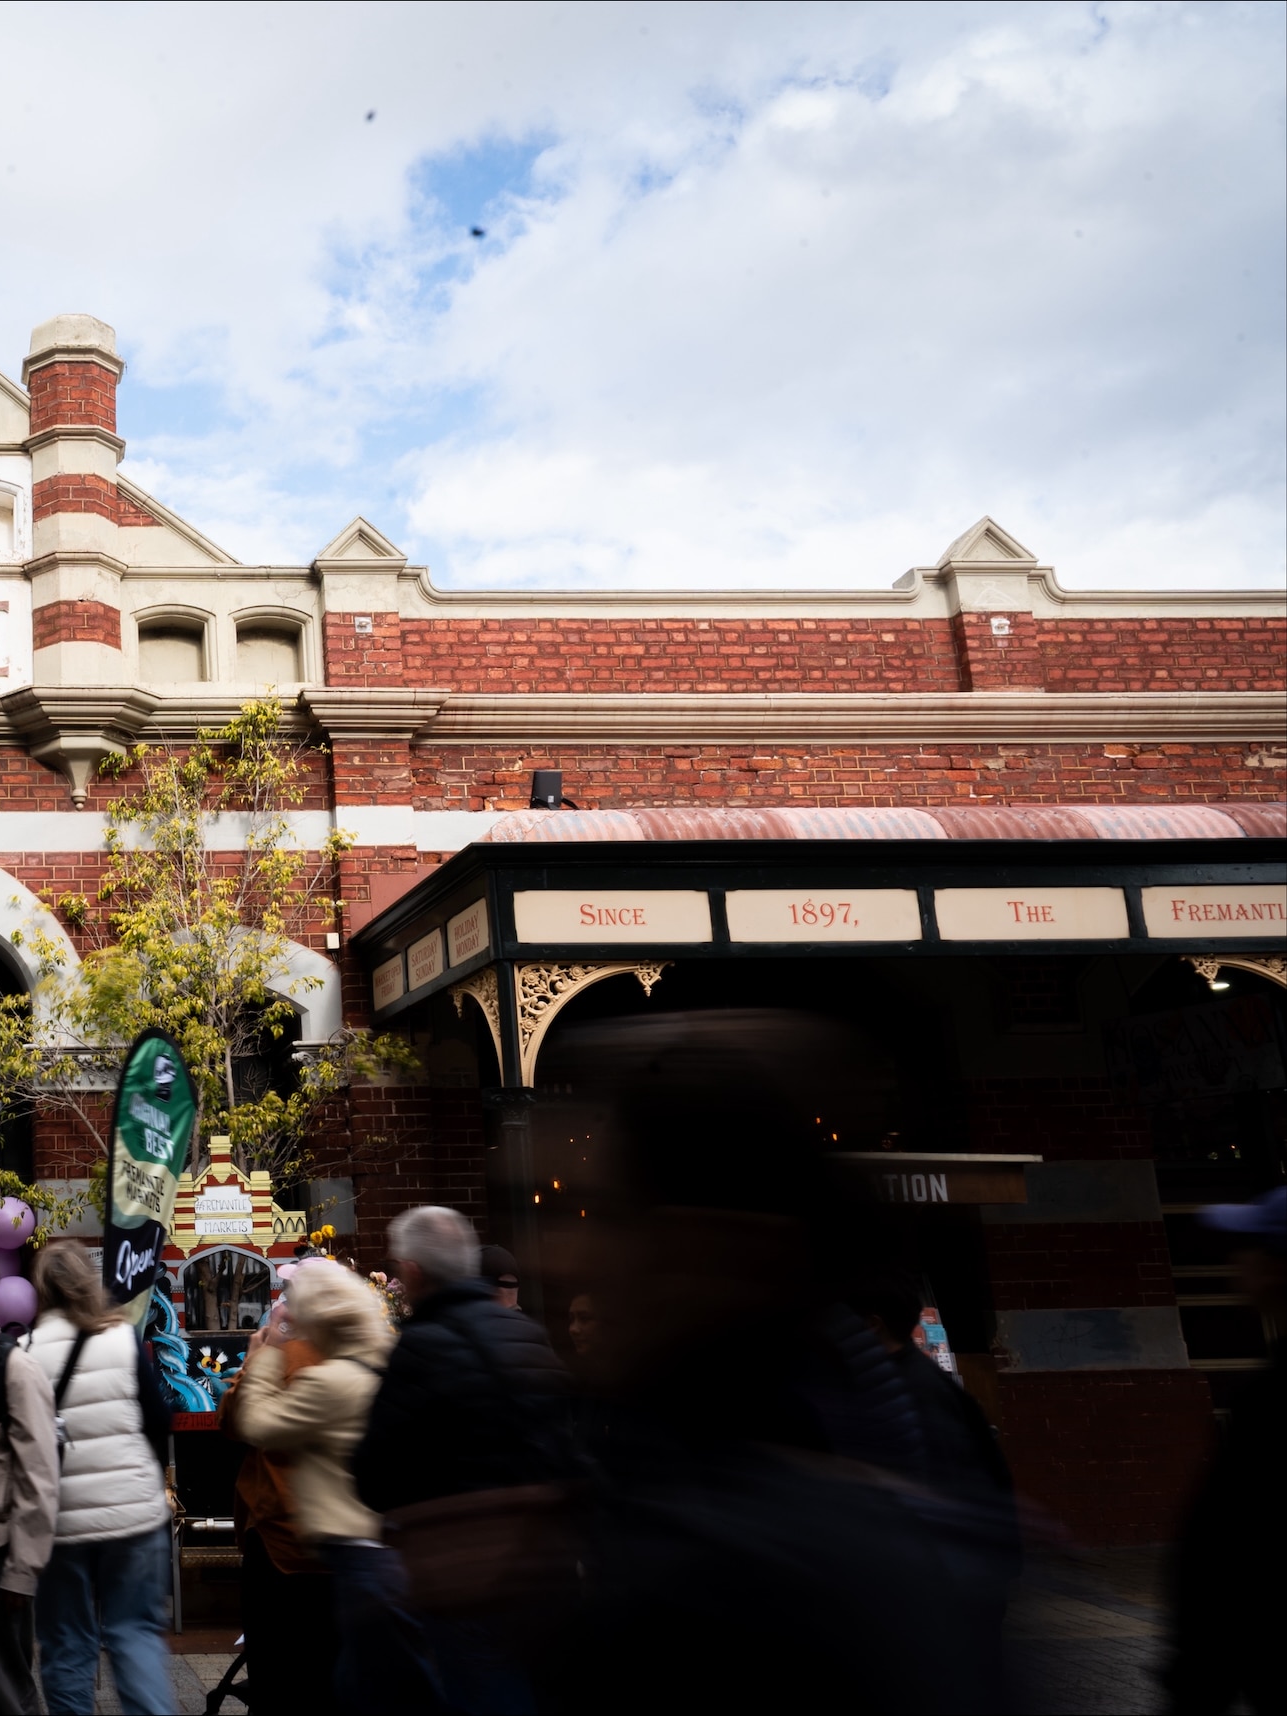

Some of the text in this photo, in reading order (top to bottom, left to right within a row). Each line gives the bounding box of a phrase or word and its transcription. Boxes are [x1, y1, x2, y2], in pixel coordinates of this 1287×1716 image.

[454, 910, 479, 940] HOLIDAY
[787, 899, 860, 928] 1897,
[411, 937, 437, 967] SATURDAY
[456, 929, 480, 958] MONDAY
[416, 956, 436, 982] SUNDAY
[144, 1127, 174, 1161] BEST
[878, 1173, 949, 1202] TION
[195, 1199, 248, 1211] #FREMANTLE
[204, 1220, 248, 1233] MARKETS
[115, 1228, 161, 1291] Open!
